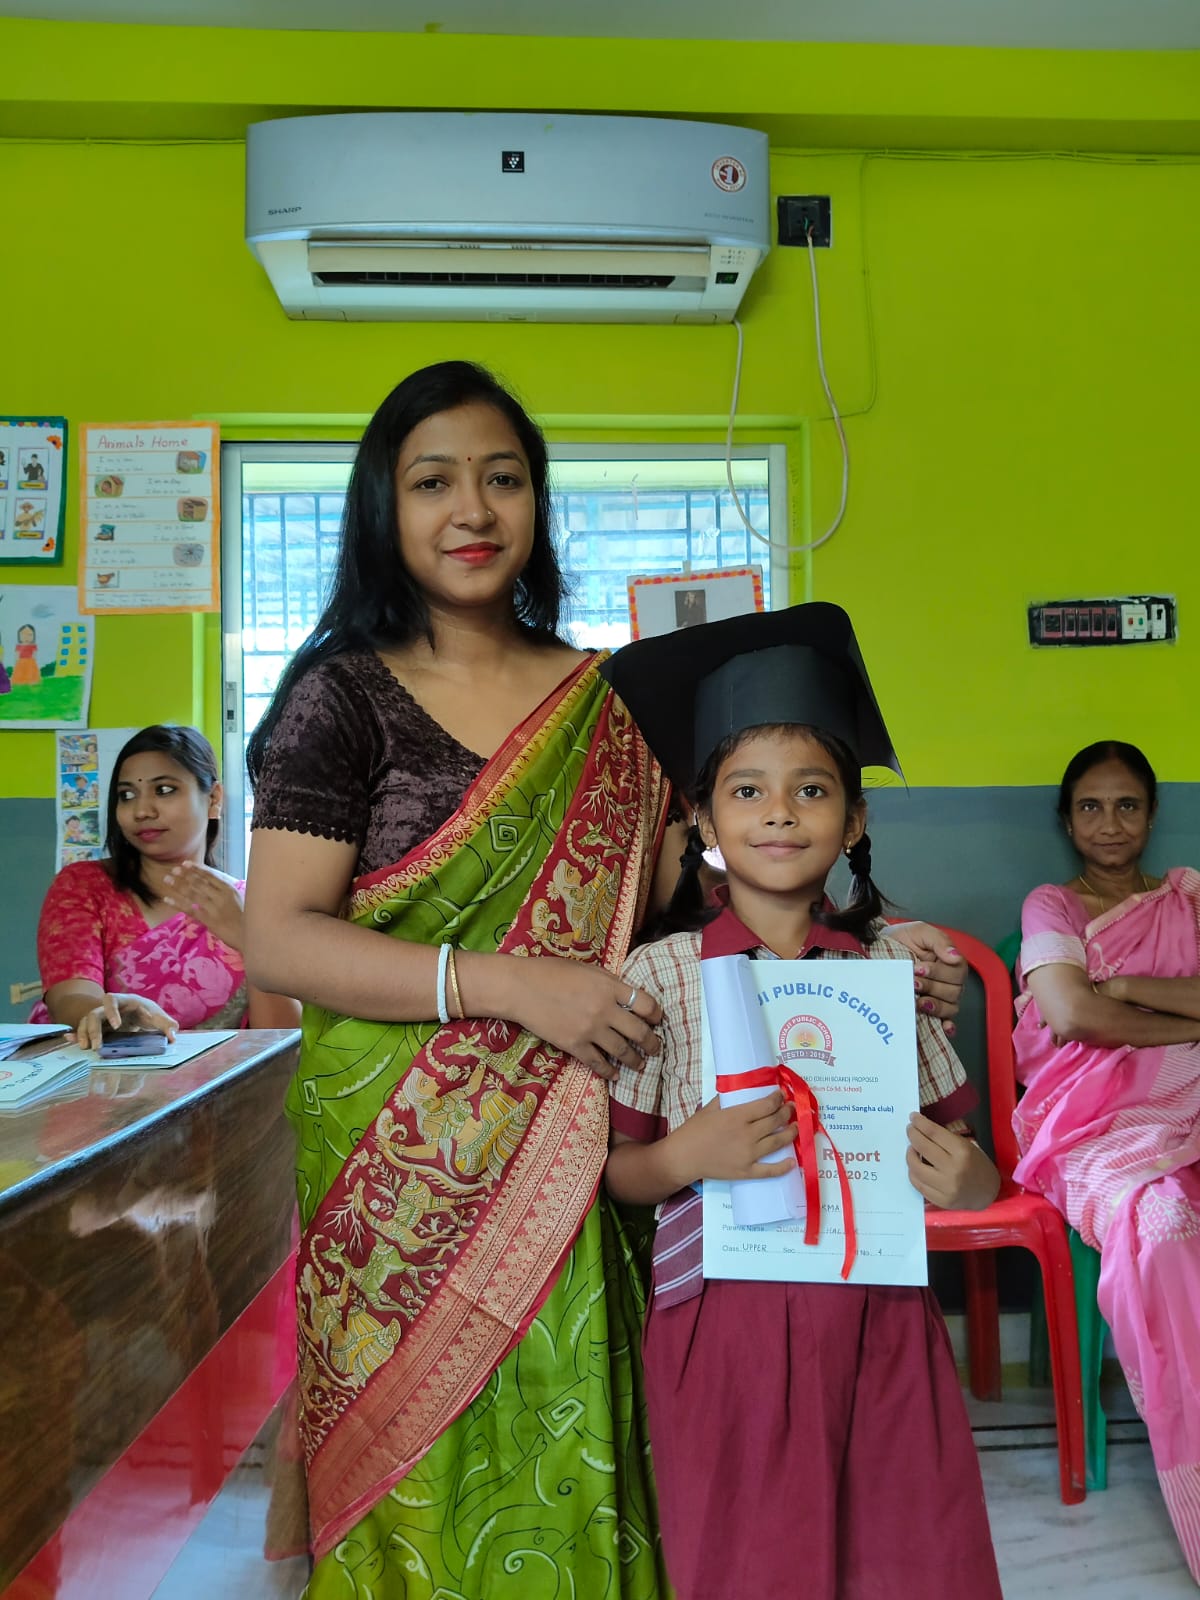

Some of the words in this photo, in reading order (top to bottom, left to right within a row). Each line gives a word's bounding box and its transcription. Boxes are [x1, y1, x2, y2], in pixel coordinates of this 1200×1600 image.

[268, 206, 302, 215] SHARP
[98, 435, 145, 449] Animals
[151, 436, 188, 448] Home
[772, 983, 834, 998] PUBLIC
[838, 991, 894, 1045] SCHOOL
[791, 1016, 817, 1025] PUBLIC
[817, 1022, 832, 1049] SCHOOL
[852, 1105, 876, 1113] Sangha
[877, 1105, 894, 1113] club)
[822, 1148, 880, 1164] Report
[743, 1242, 767, 1253] UPPER
